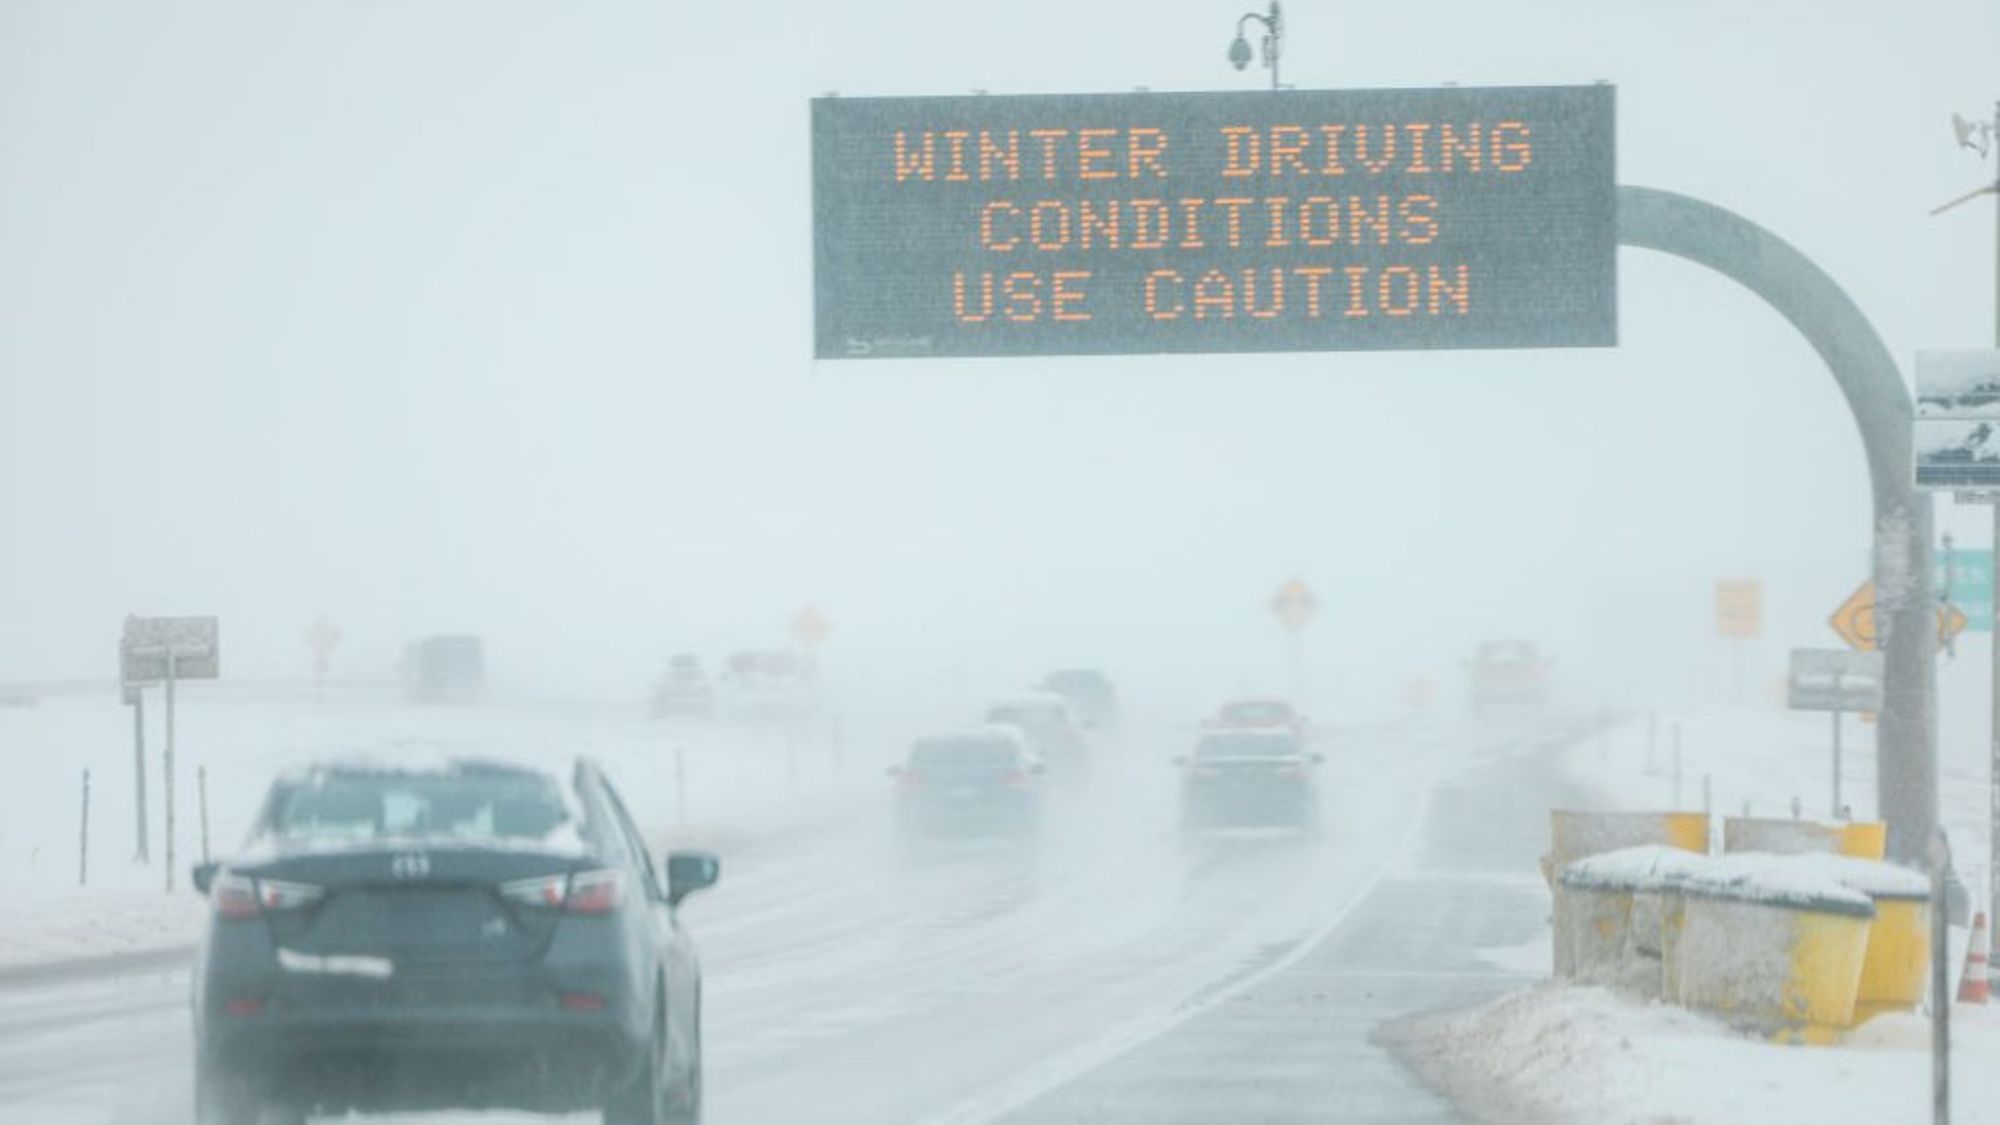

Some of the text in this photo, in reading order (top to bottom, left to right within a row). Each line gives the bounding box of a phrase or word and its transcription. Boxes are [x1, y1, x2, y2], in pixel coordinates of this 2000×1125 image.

[895, 121, 1532, 181] WINTER DRIVING
[980, 195, 1438, 251] CONDITIONS
[954, 265, 1470, 321] USE CAUTION
